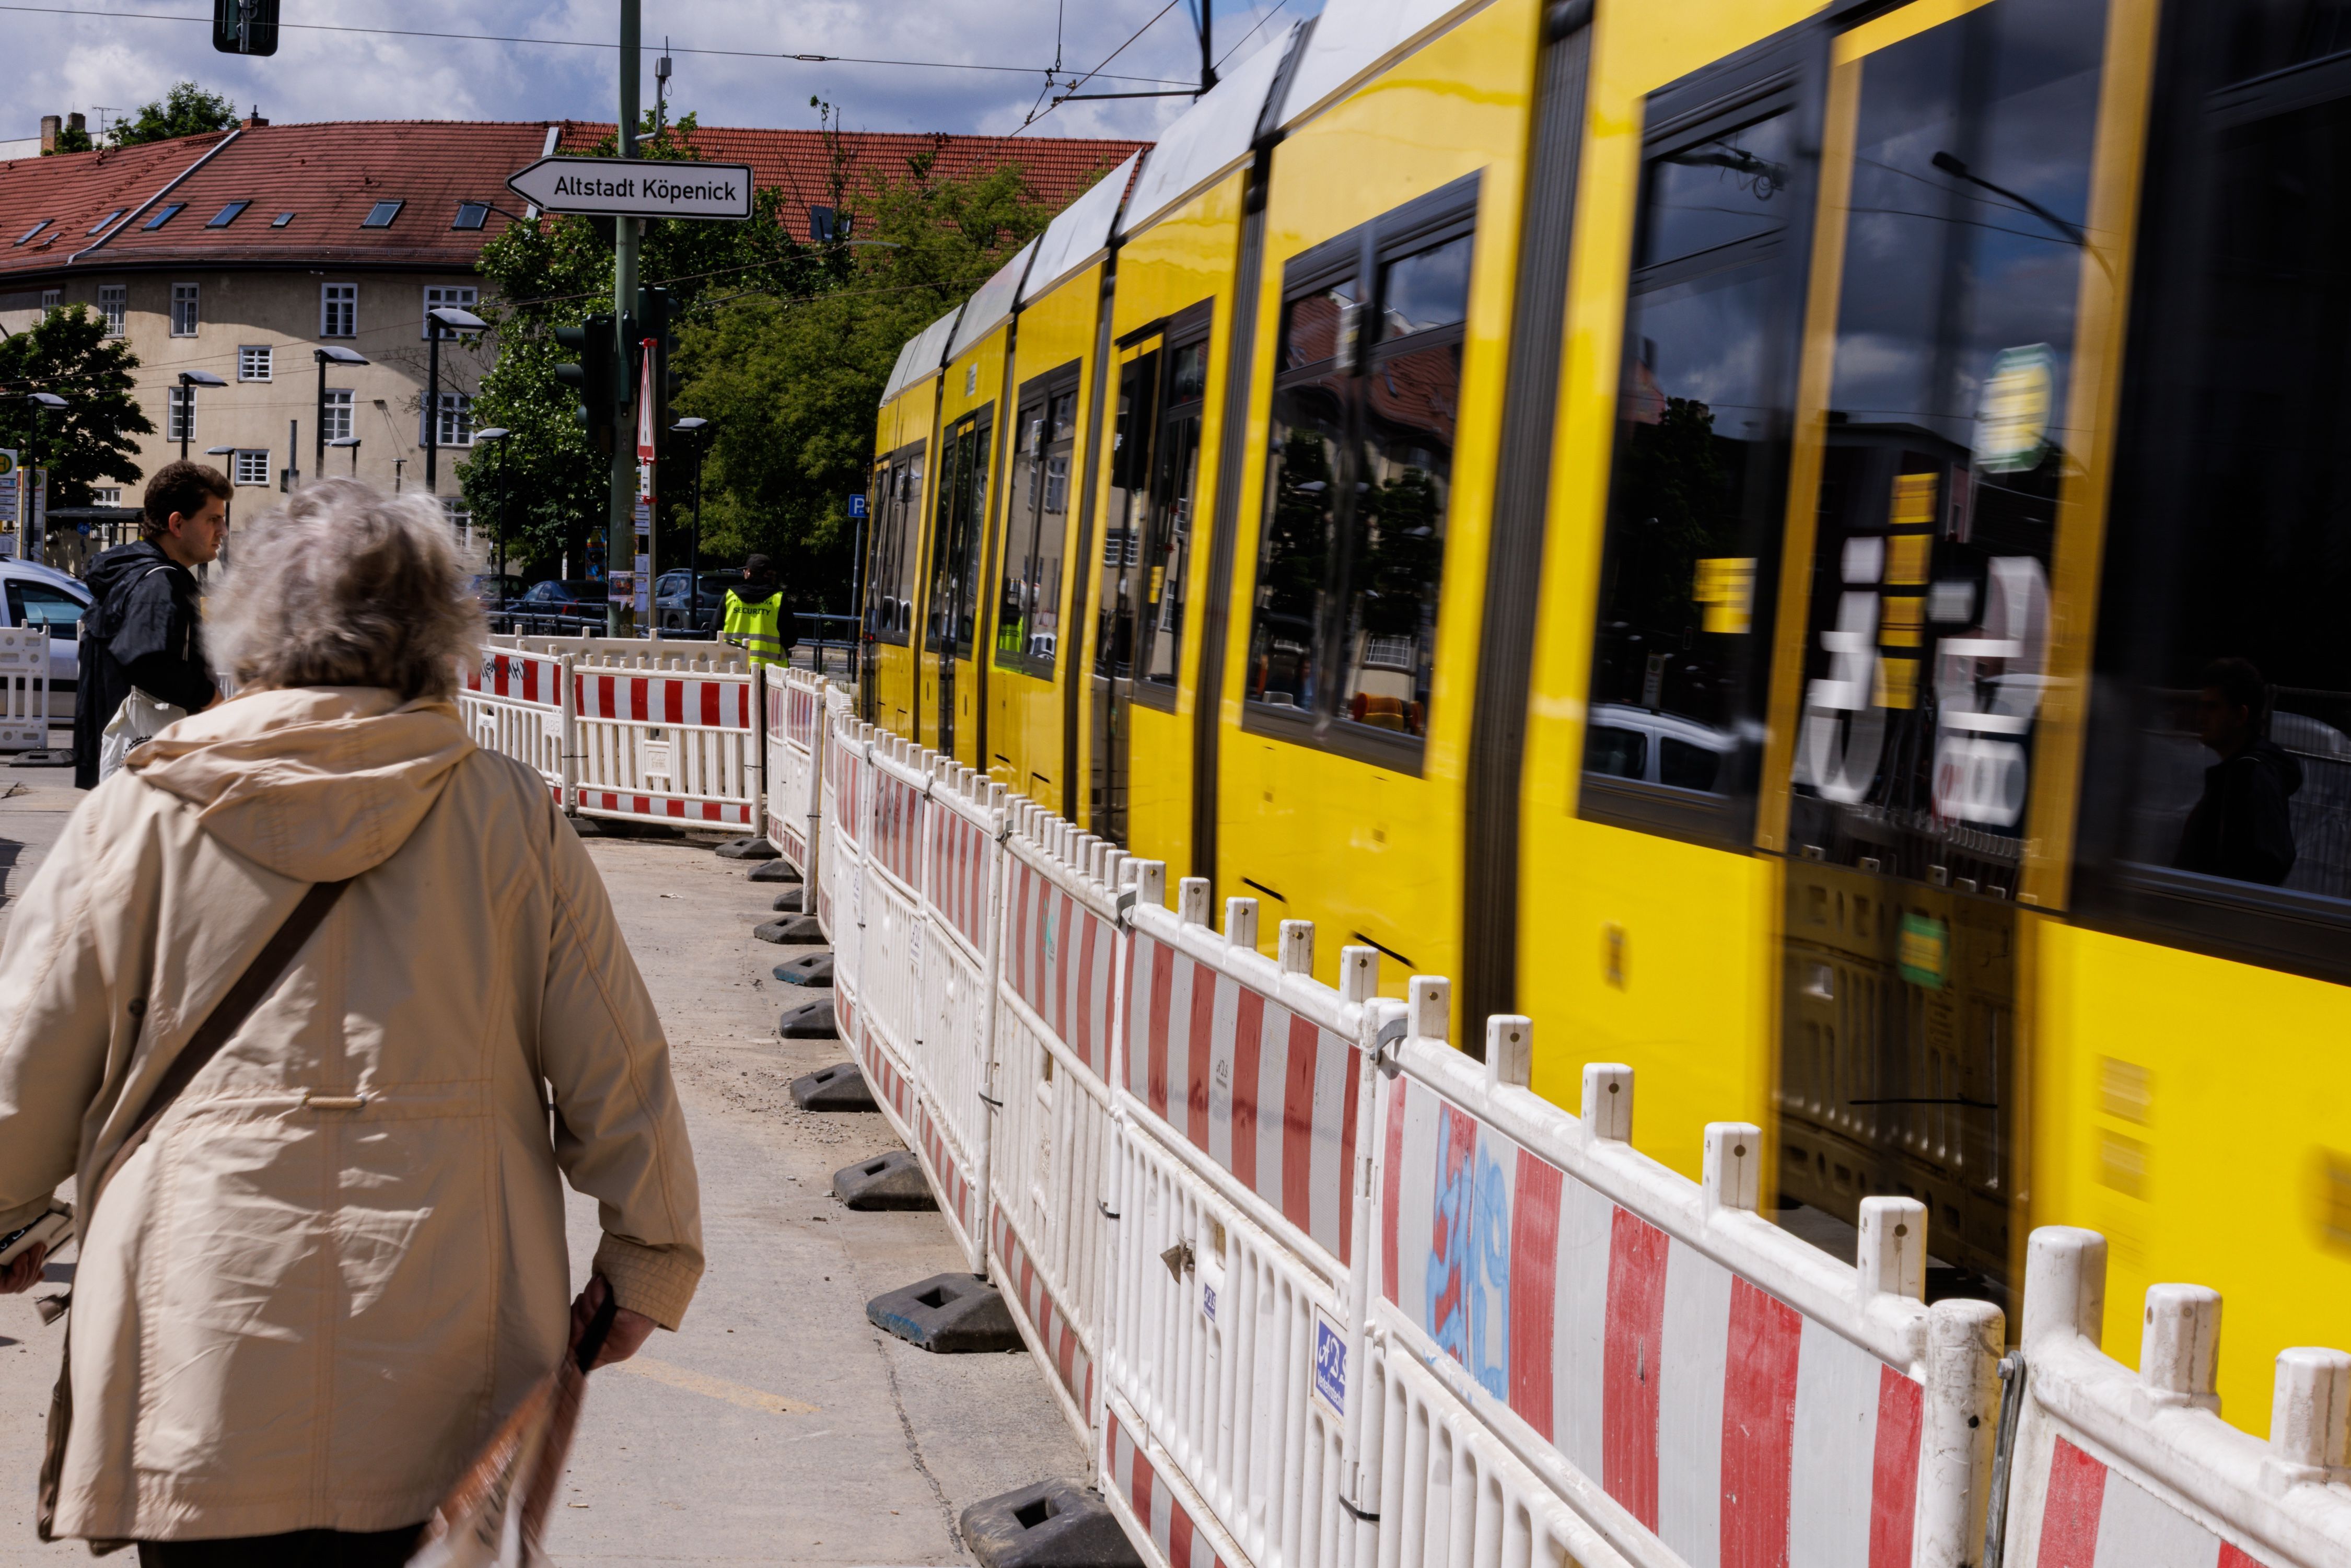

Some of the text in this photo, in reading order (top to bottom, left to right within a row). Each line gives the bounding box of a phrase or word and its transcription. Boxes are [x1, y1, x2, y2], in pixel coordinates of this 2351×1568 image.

[554, 176, 737, 204] Altstadt Köpenick
[733, 607, 771, 615] SECURITY
